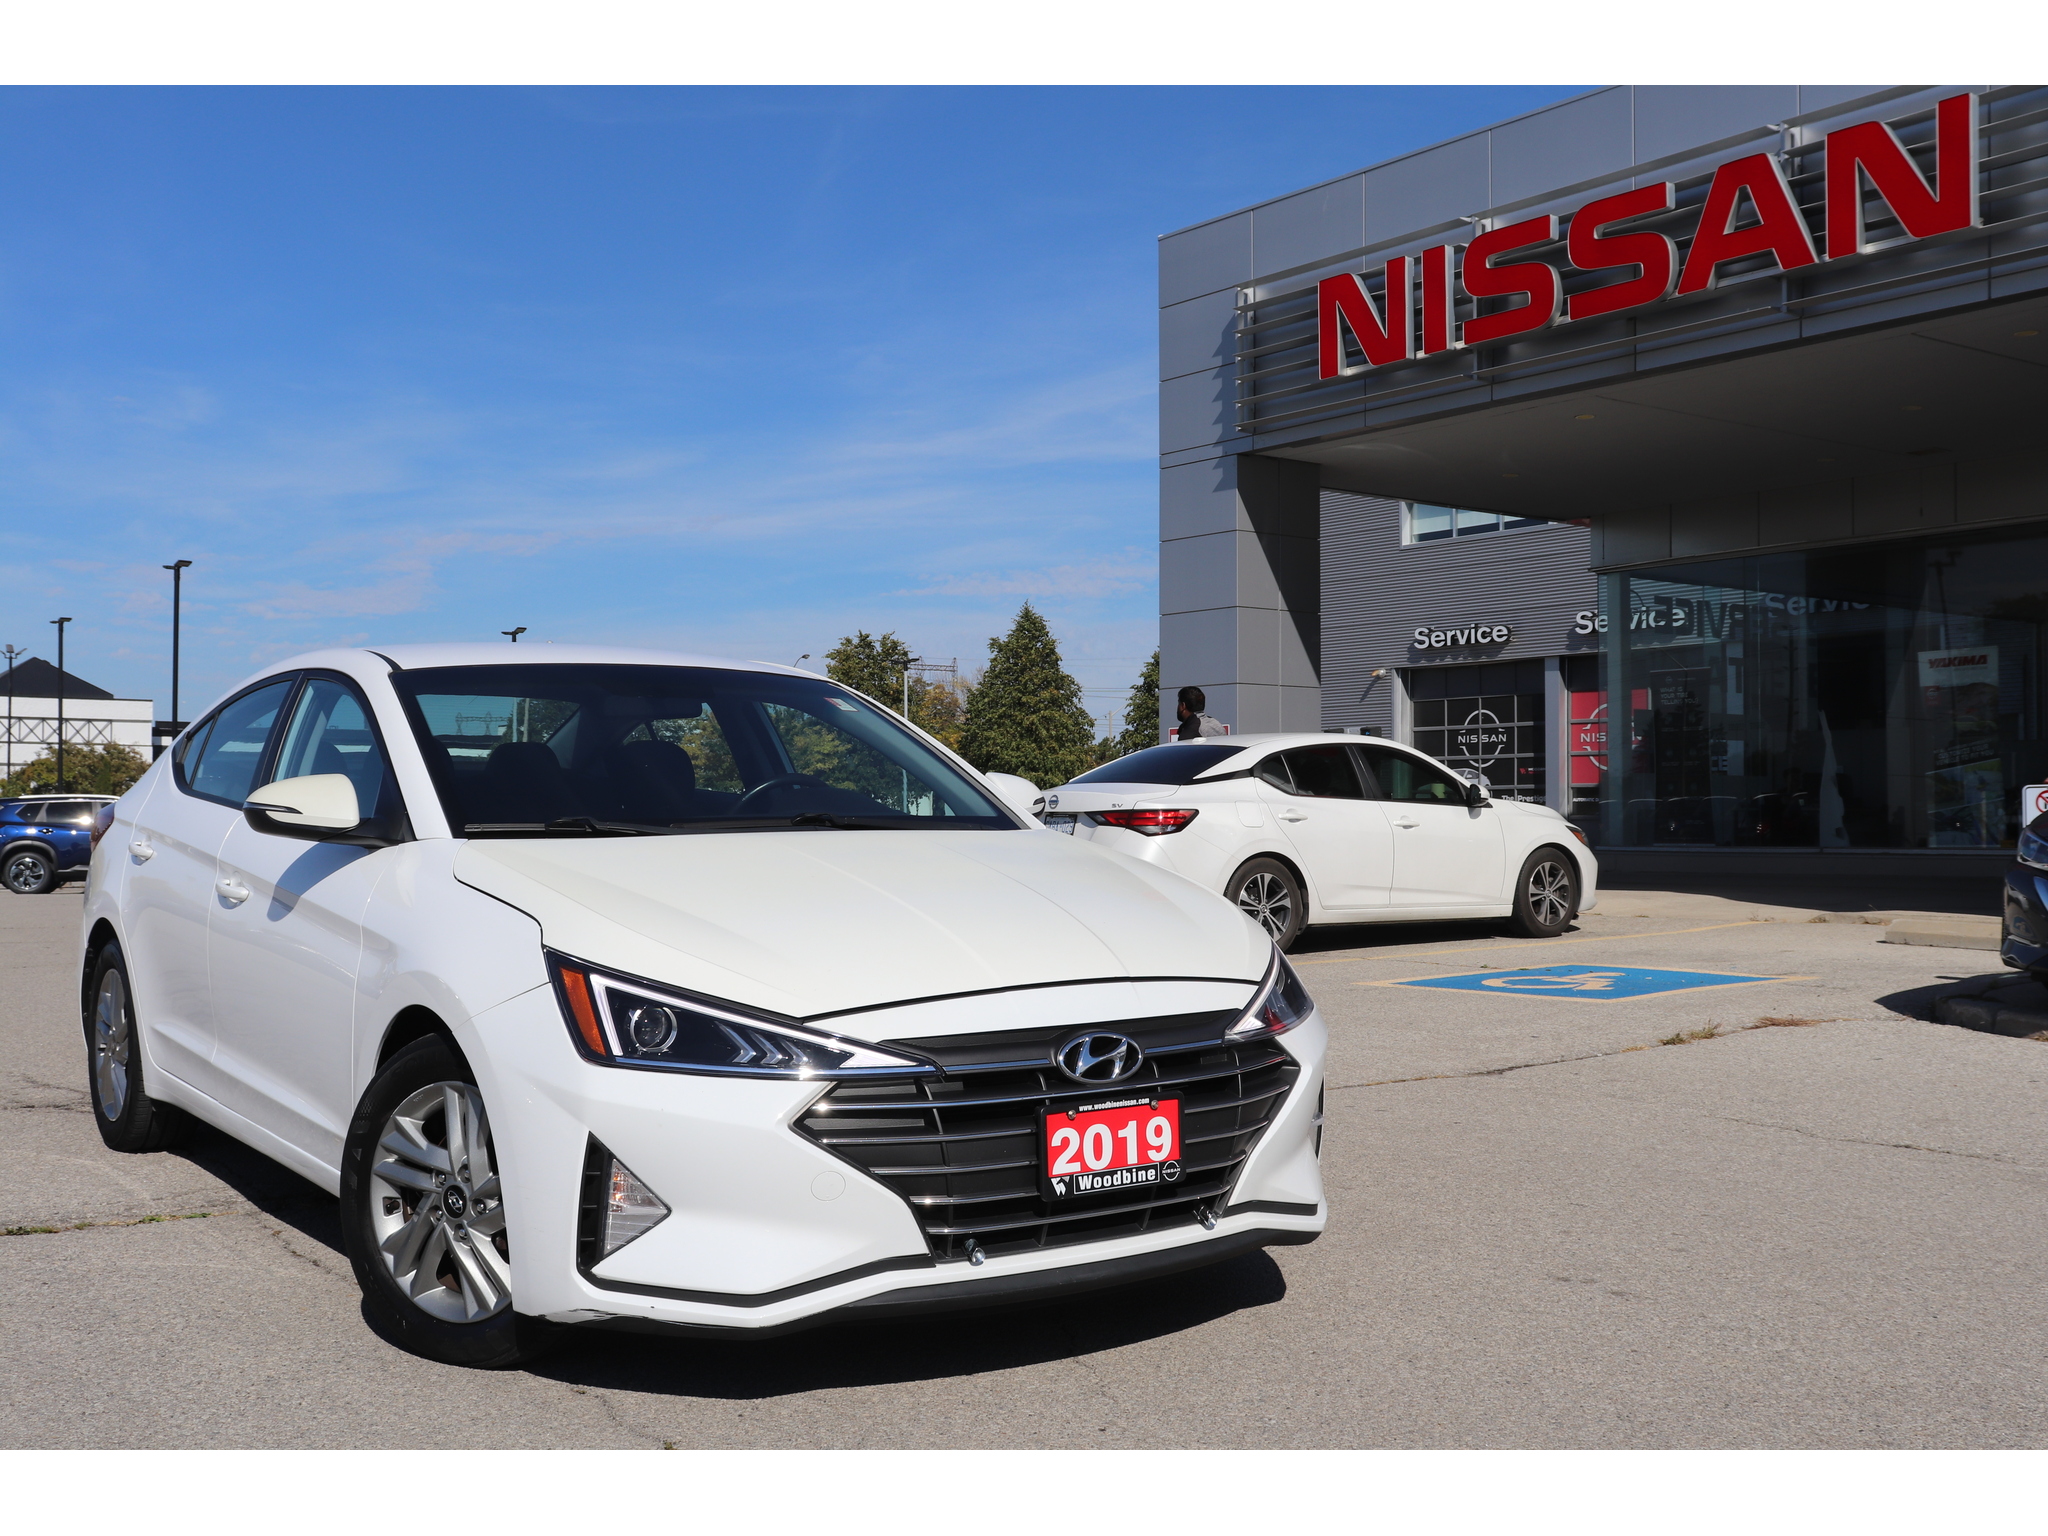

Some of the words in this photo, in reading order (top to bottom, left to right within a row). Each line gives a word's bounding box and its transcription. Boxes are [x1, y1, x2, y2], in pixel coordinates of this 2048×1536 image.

[1318, 92, 1979, 380] NISSAN
[1574, 606, 1686, 635] Sevice
[1413, 624, 1509, 649] Service
[1928, 654, 1988, 669] YAKIMA
[1457, 733, 1507, 744] NISSAN
[1078, 1097, 1150, 1112] www.woodbinenissan.com
[1051, 1115, 1173, 1175] 2019
[1078, 1168, 1156, 1191] Woodbine
